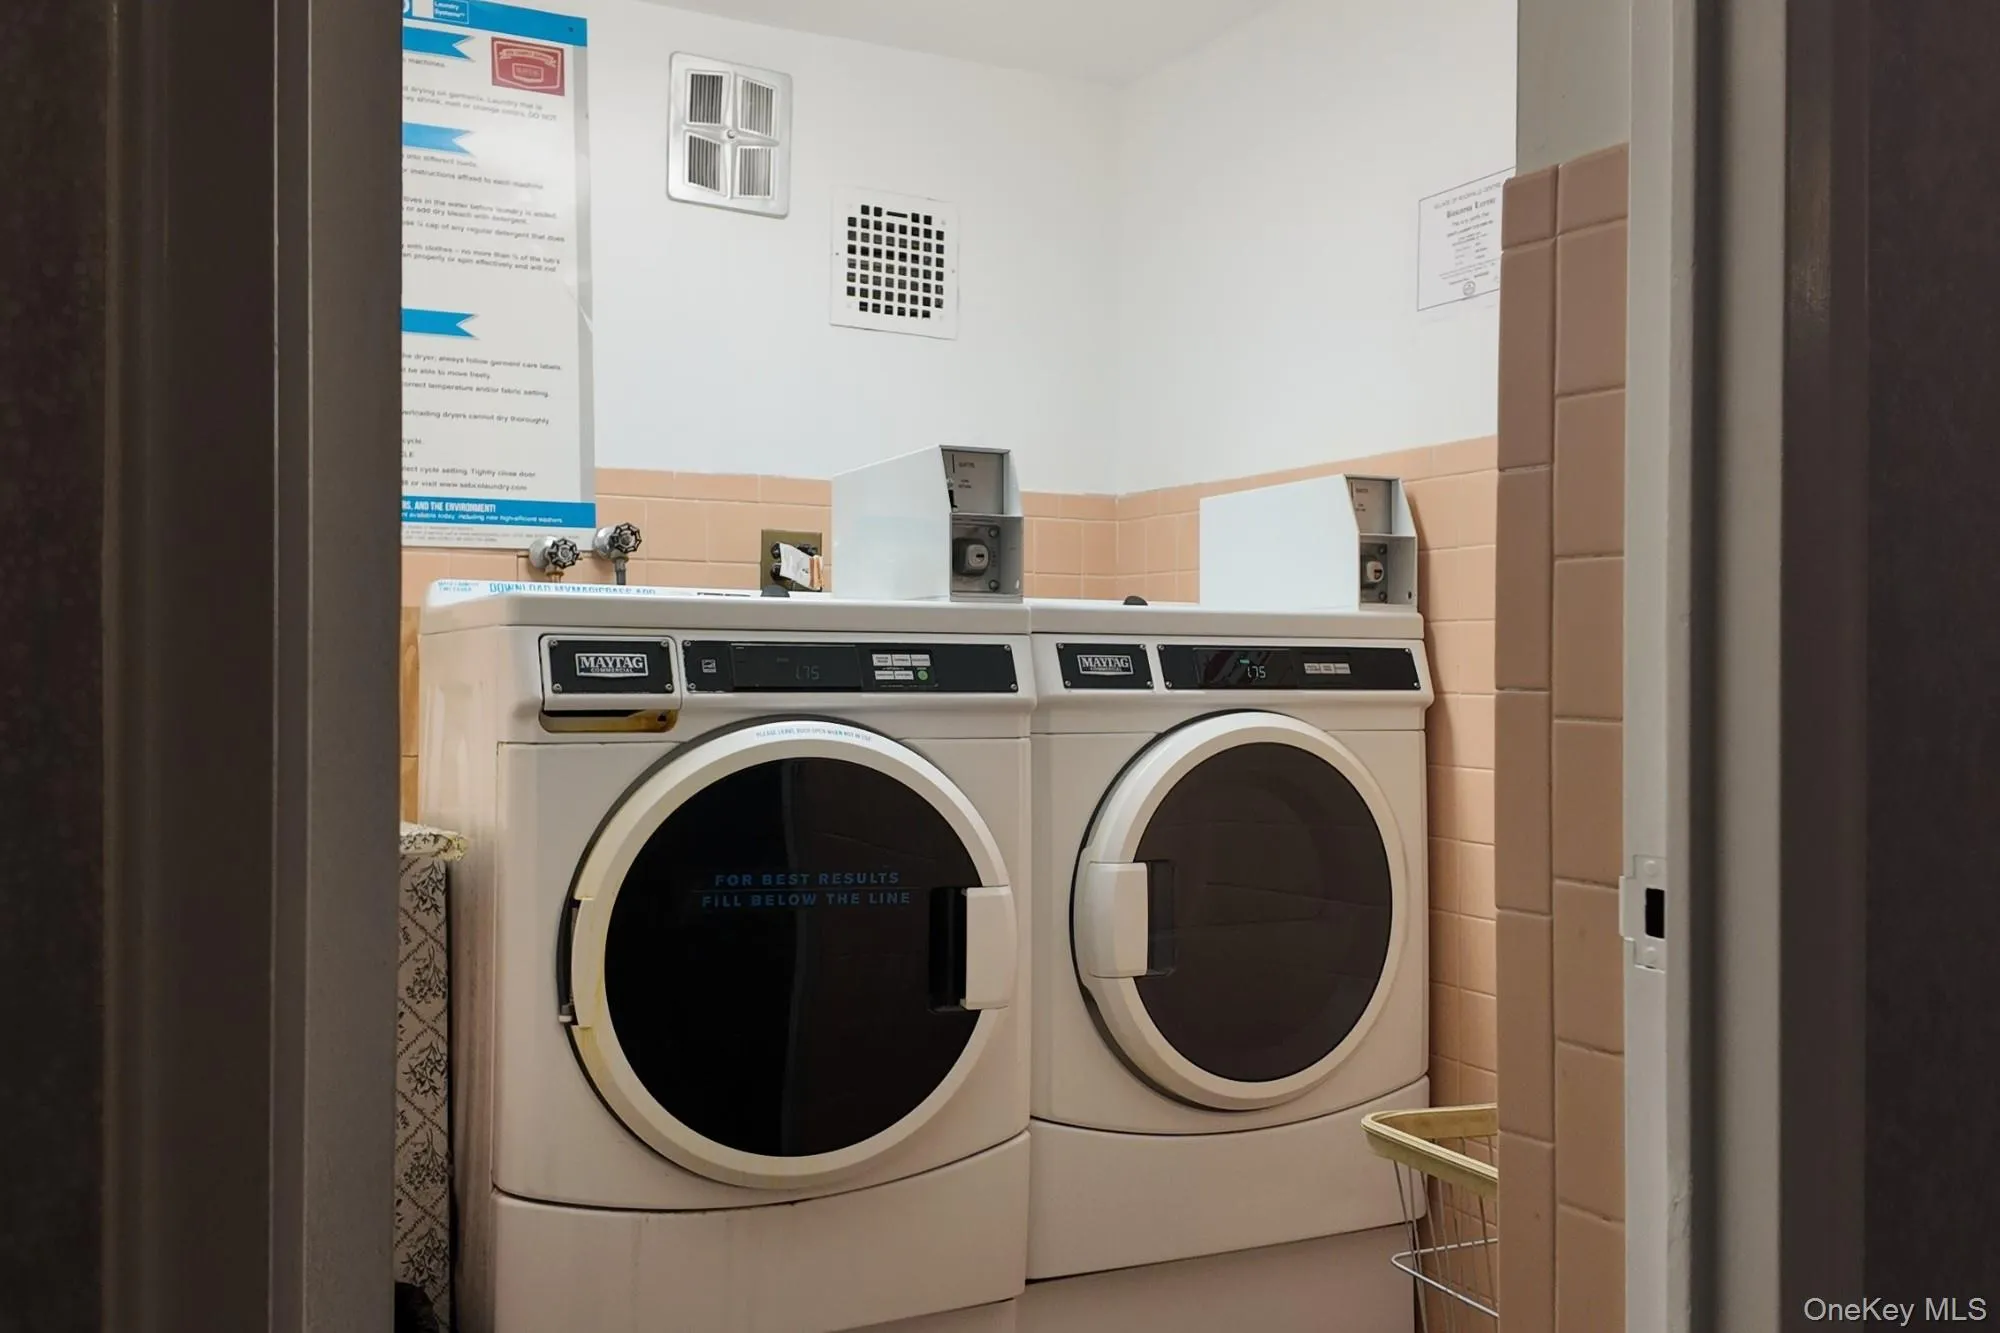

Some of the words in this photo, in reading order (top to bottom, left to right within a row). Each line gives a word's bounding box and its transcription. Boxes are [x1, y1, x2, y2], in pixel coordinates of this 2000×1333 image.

[415, 502, 429, 511] AND
[430, 503, 443, 512] THE
[445, 503, 496, 513] ENVIRONMENT!
[580, 657, 643, 668] MAYTAG
[1081, 656, 1130, 668] MAYTAG
[715, 875, 752, 887] FOR
[762, 874, 810, 886] BEST
[819, 872, 899, 884] RESULTS
[702, 895, 742, 908] FILL
[750, 894, 817, 907] BELOW
[826, 893, 860, 905] THE
[869, 892, 910, 904] LINE
